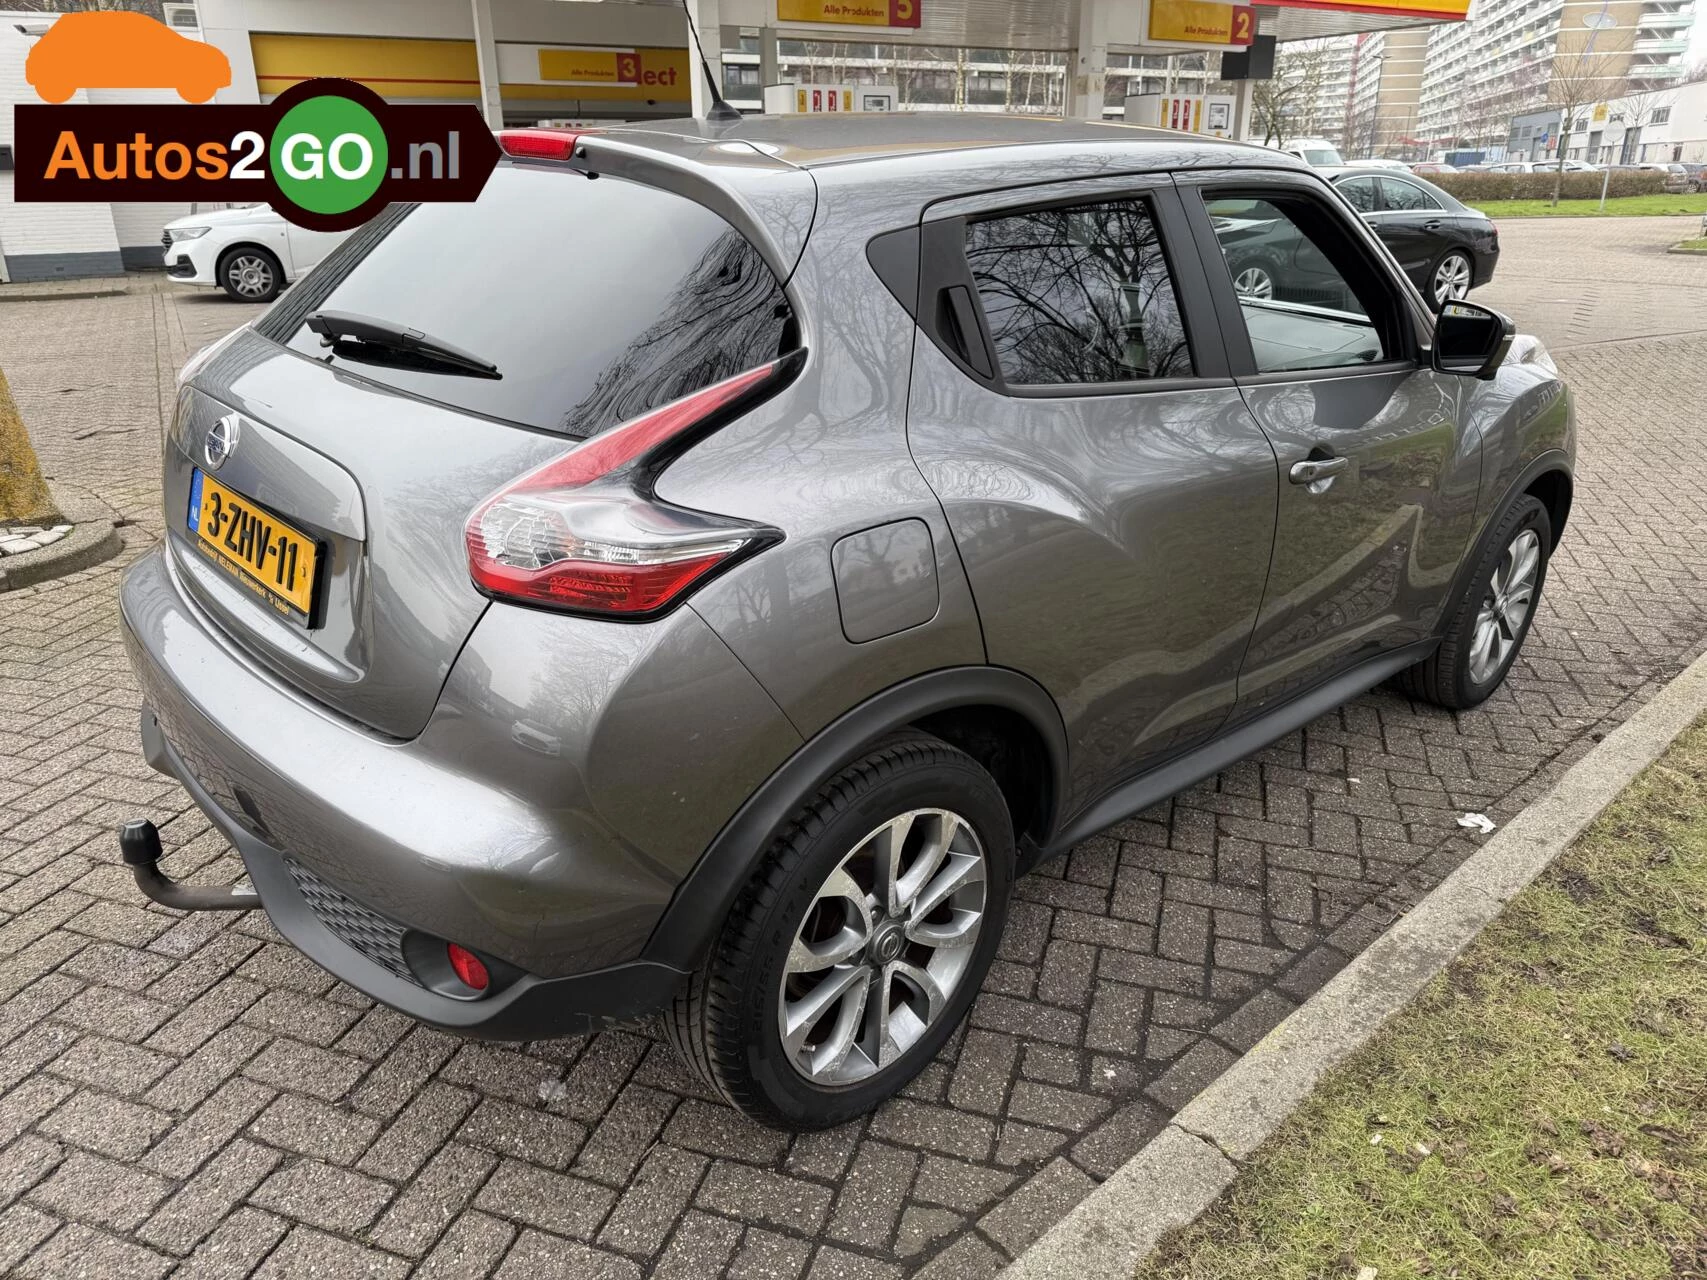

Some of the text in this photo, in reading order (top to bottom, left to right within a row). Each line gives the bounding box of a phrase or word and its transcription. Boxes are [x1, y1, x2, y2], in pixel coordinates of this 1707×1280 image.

[824, 4, 885, 17] Alle Produkten
[1236, 12, 1250, 39] 2
[623, 58, 636, 78] 3
[637, 67, 677, 86] ect
[192, 504, 199, 522] NL
[207, 491, 298, 592] 3-ZHV-11
